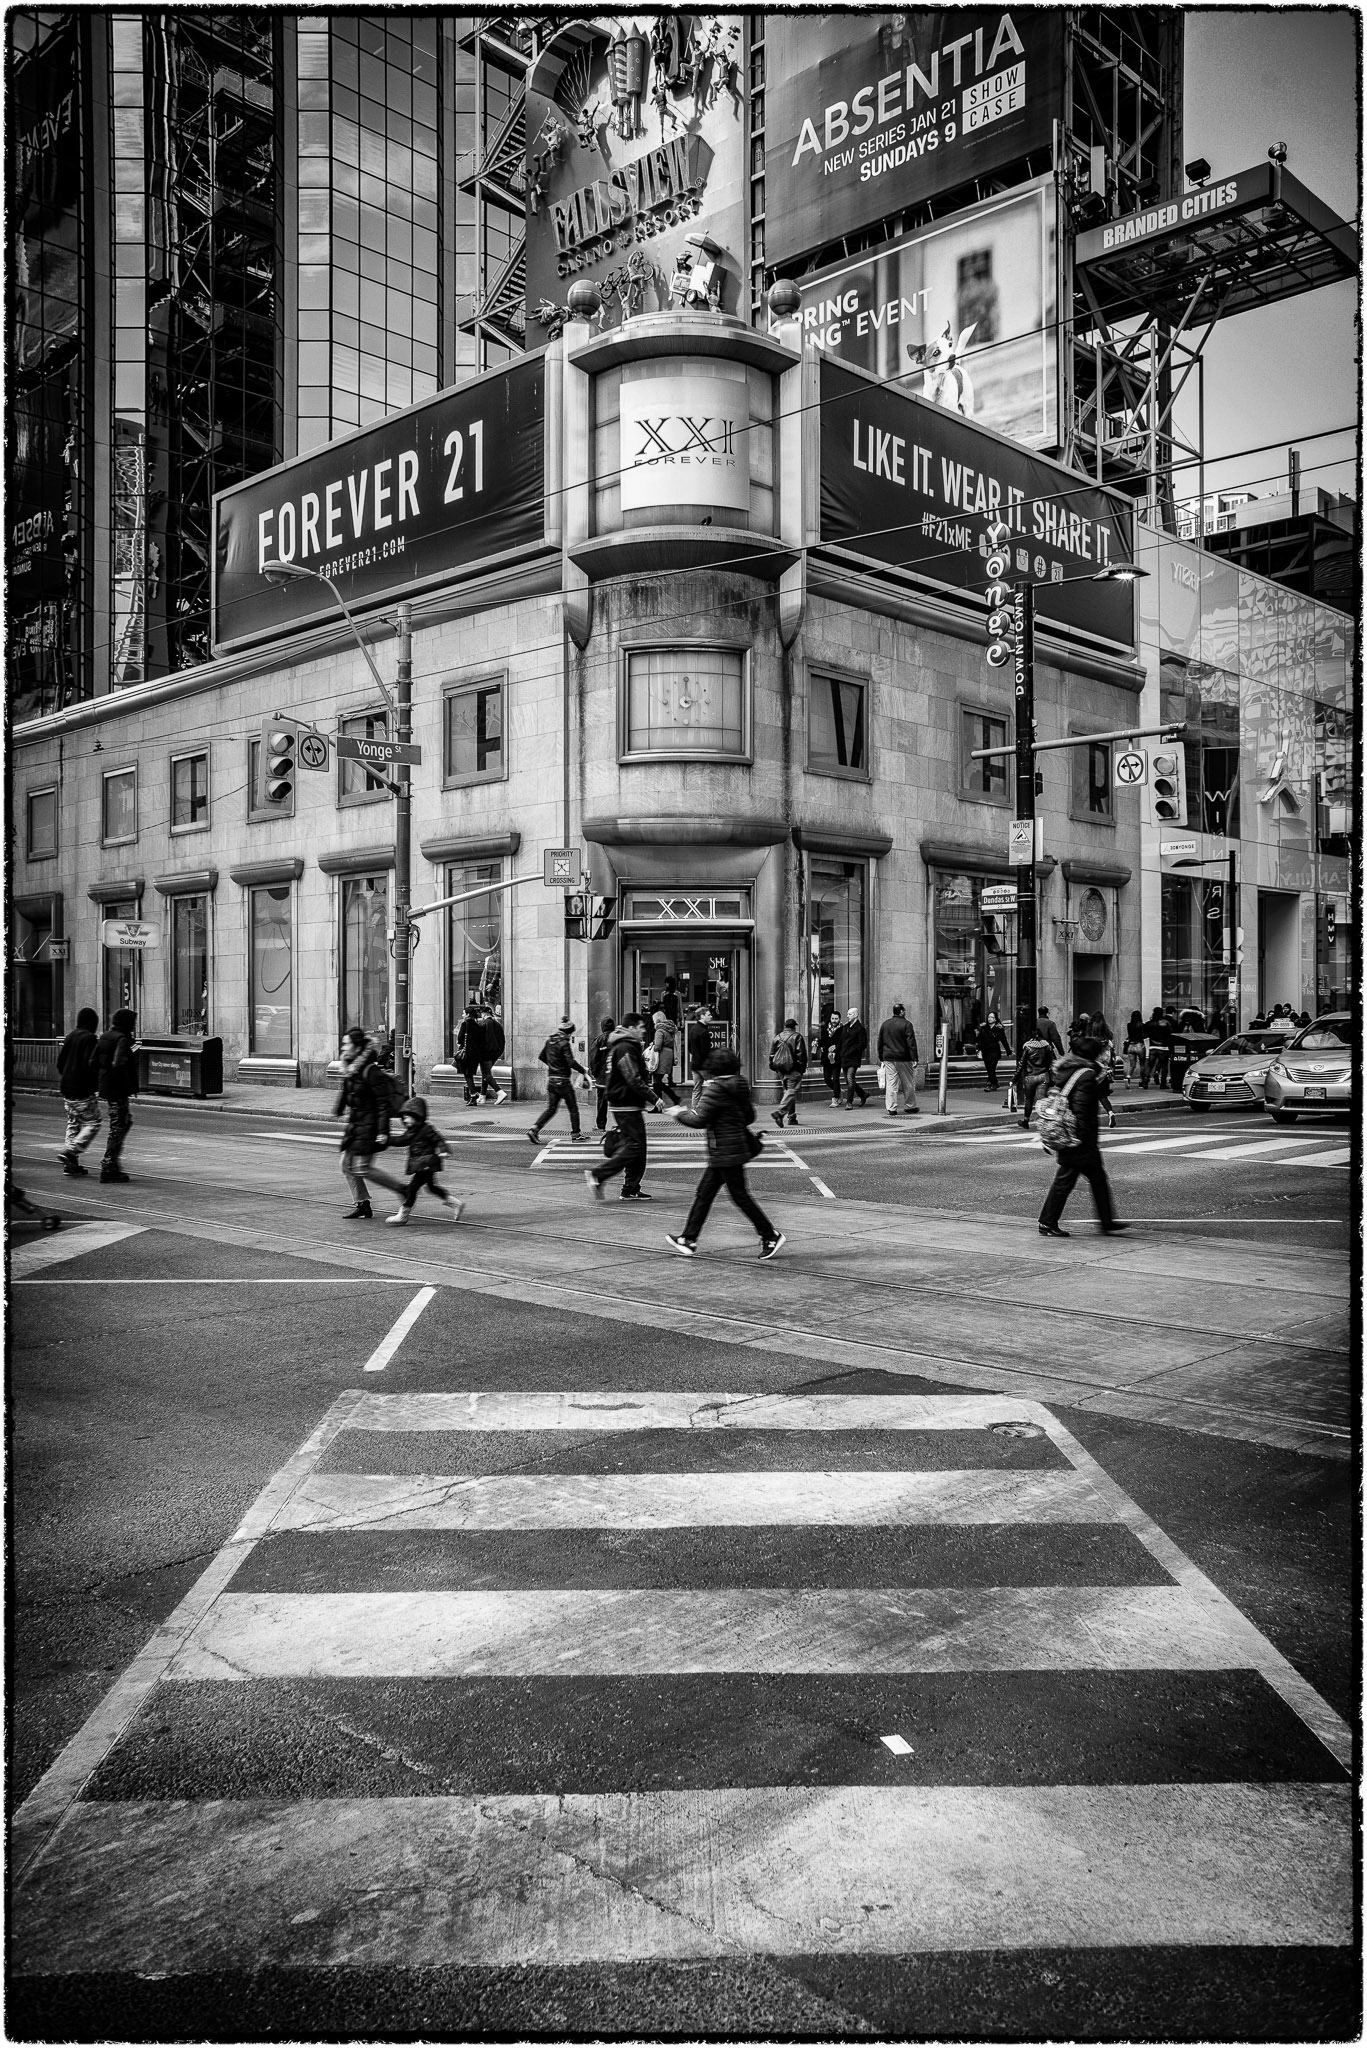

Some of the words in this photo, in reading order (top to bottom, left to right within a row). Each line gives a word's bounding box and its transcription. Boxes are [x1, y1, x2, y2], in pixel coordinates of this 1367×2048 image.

[791, 13, 1025, 167] ABSENTIA
[969, 66, 1019, 105] SHOW
[969, 91, 1017, 128] CASE
[823, 147, 855, 176] NEW
[858, 123, 906, 159] SERIES
[909, 107, 937, 135] JAN
[941, 98, 956, 120] 21
[860, 129, 939, 182] SUNDAYS
[944, 122, 957, 142] 9
[548, 132, 695, 254] FALLSVIEW
[1103, 204, 1178, 249] BRANDED
[1181, 181, 1238, 220] CITIES
[557, 239, 614, 278] CASINO
[633, 198, 704, 244] RESORT
[856, 286, 933, 337] EVENT
[633, 416, 736, 456] XXI
[633, 456, 737, 468] FOREVER
[258, 449, 421, 575] FOREVER
[443, 419, 484, 505] 21
[853, 418, 906, 486] LIKE
[912, 444, 935, 498] IT.
[941, 456, 1001, 522] WEAR
[1007, 485, 1027, 534] IT.
[1032, 497, 1092, 560] SHARE
[1096, 523, 1112, 567] IT.
[921, 510, 972, 551] #F21xME
[318, 535, 405, 581] FOREVER21.COM
[1014, 592, 1025, 696] DOWNTOWN
[356, 740, 393, 761] Yonge
[394, 745, 402, 754] St
[655, 897, 718, 919] XXI
[983, 896, 1004, 904] Dundas
[1010, 895, 1016, 903] W
[119, 938, 147, 947] Subway
[1058, 930, 1075, 939] XXI
